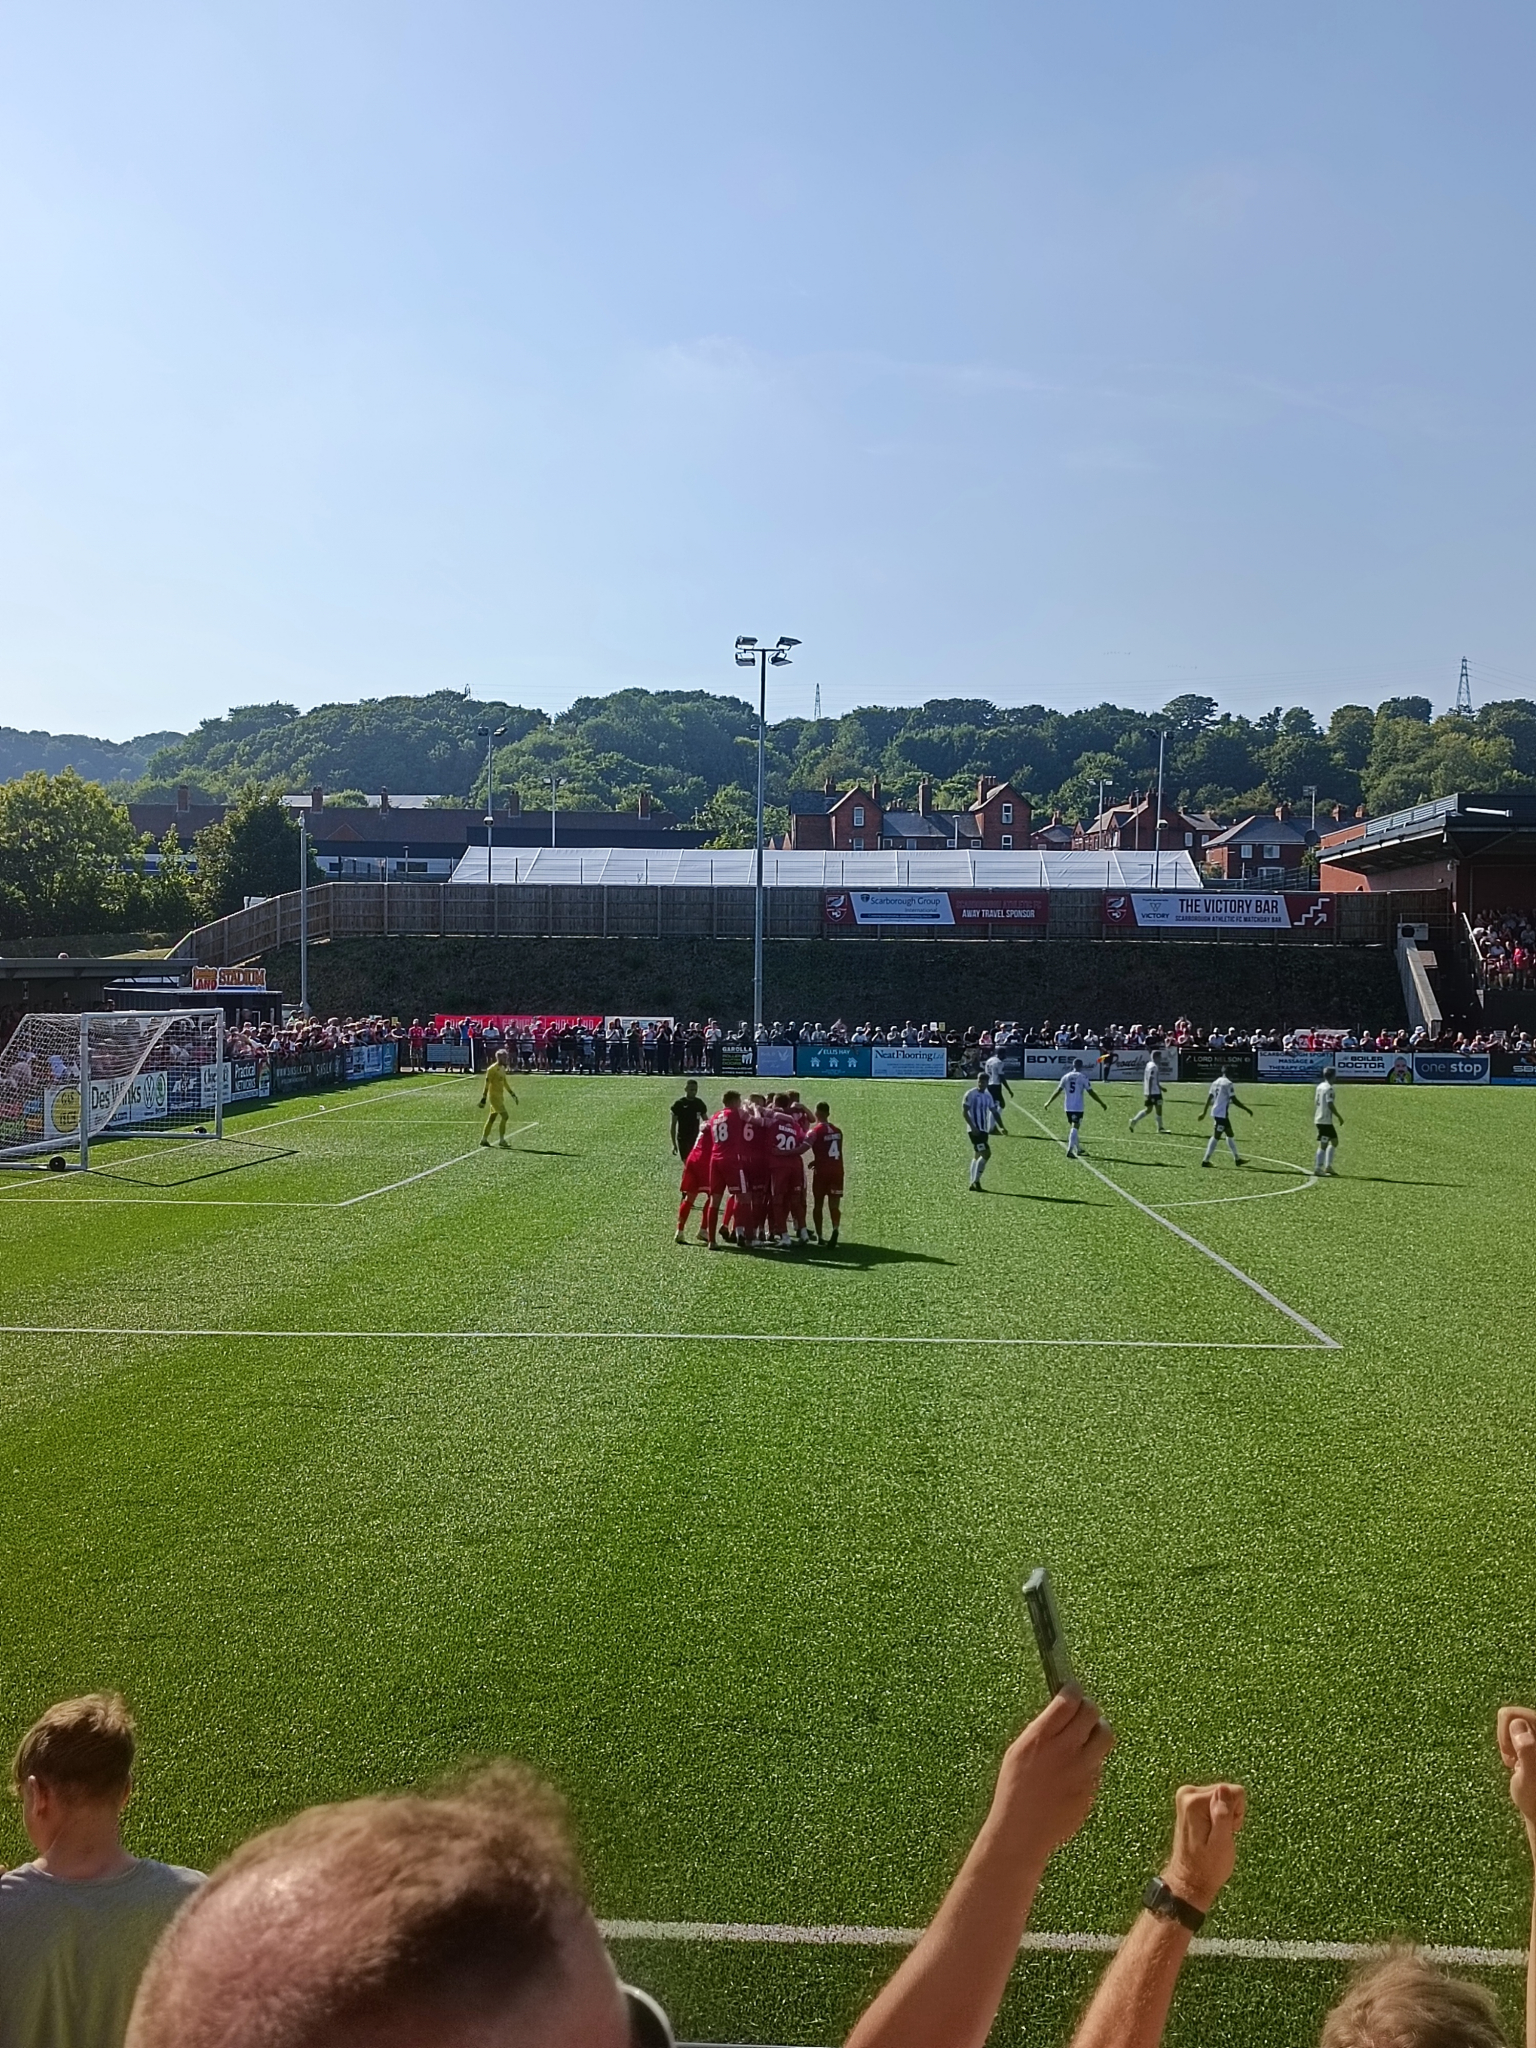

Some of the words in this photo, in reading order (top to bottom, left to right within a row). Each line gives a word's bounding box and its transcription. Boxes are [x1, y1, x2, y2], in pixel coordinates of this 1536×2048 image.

[870, 897, 915, 906] Scarborough
[917, 897, 941, 906] Group
[1178, 899, 1202, 913] THE
[1203, 899, 1253, 914] VICTORY
[1255, 900, 1279, 914] BAR
[962, 909, 981, 918] AWAY
[981, 909, 1005, 918] TRAVEL
[1005, 909, 1035, 918] SPONSOR
[193, 978, 218, 991] LAND
[219, 969, 266, 986] STADIUM
[1026, 1055, 1077, 1064] BOYES
[235, 1061, 257, 1079] Practical
[1421, 1063, 1446, 1073] one
[1450, 1061, 1482, 1077] stop
[1513, 1065, 1536, 1073] SB
[92, 1086, 111, 1110] Des
[111, 1081, 142, 1106] Wnks
[1069, 1081, 1076, 1094] 5
[712, 1121, 729, 1143] 18
[743, 1122, 754, 1142] 6
[776, 1133, 796, 1151] 20
[828, 1140, 840, 1160] 4
